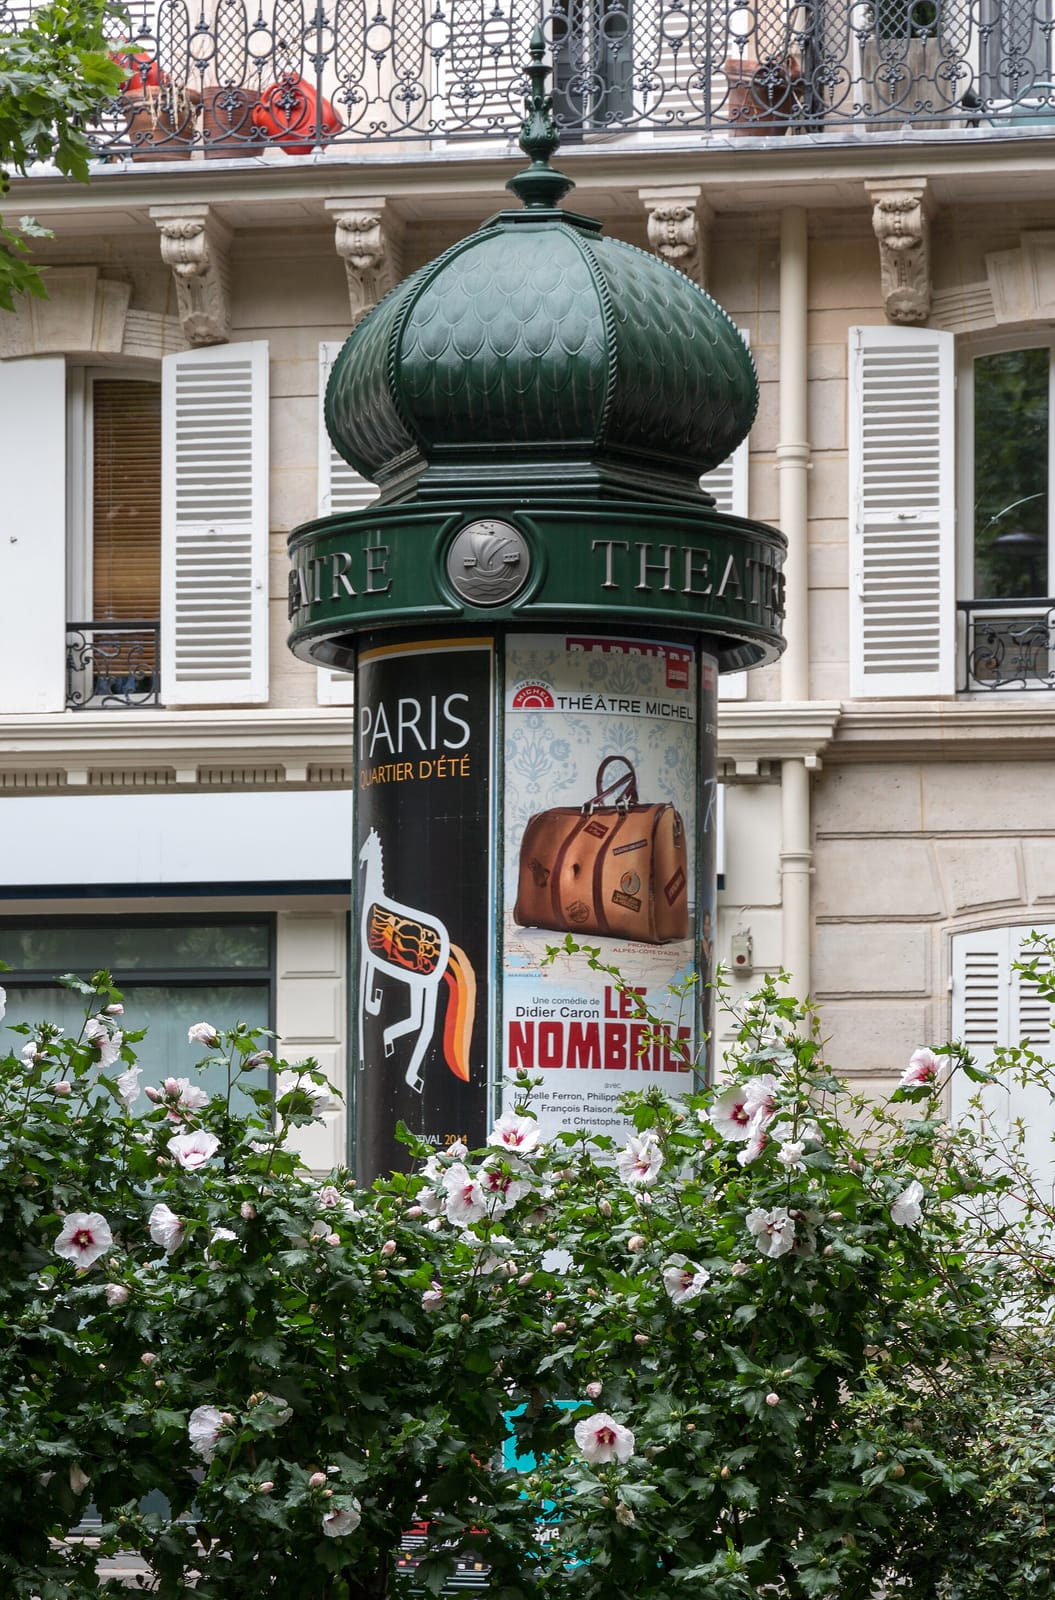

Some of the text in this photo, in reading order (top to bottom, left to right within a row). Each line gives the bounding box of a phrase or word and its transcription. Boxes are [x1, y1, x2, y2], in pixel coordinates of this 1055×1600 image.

[516, 689, 549, 702] MICHEL
[557, 694, 693, 720] THÉÂTRE MICHEL
[359, 693, 470, 760] PARIS
[360, 754, 470, 790] QUARTIER D'ÉTÉ
[532, 996, 600, 1006] Une comédie de
[605, 985, 647, 1019] LES
[516, 1006, 600, 1019] Didier Caron
[508, 1020, 692, 1073] NOMBRILS
[552, 1091, 585, 1102] Ferron,
[541, 1104, 580, 1114] François
[574, 1117, 621, 1127] Christophe
